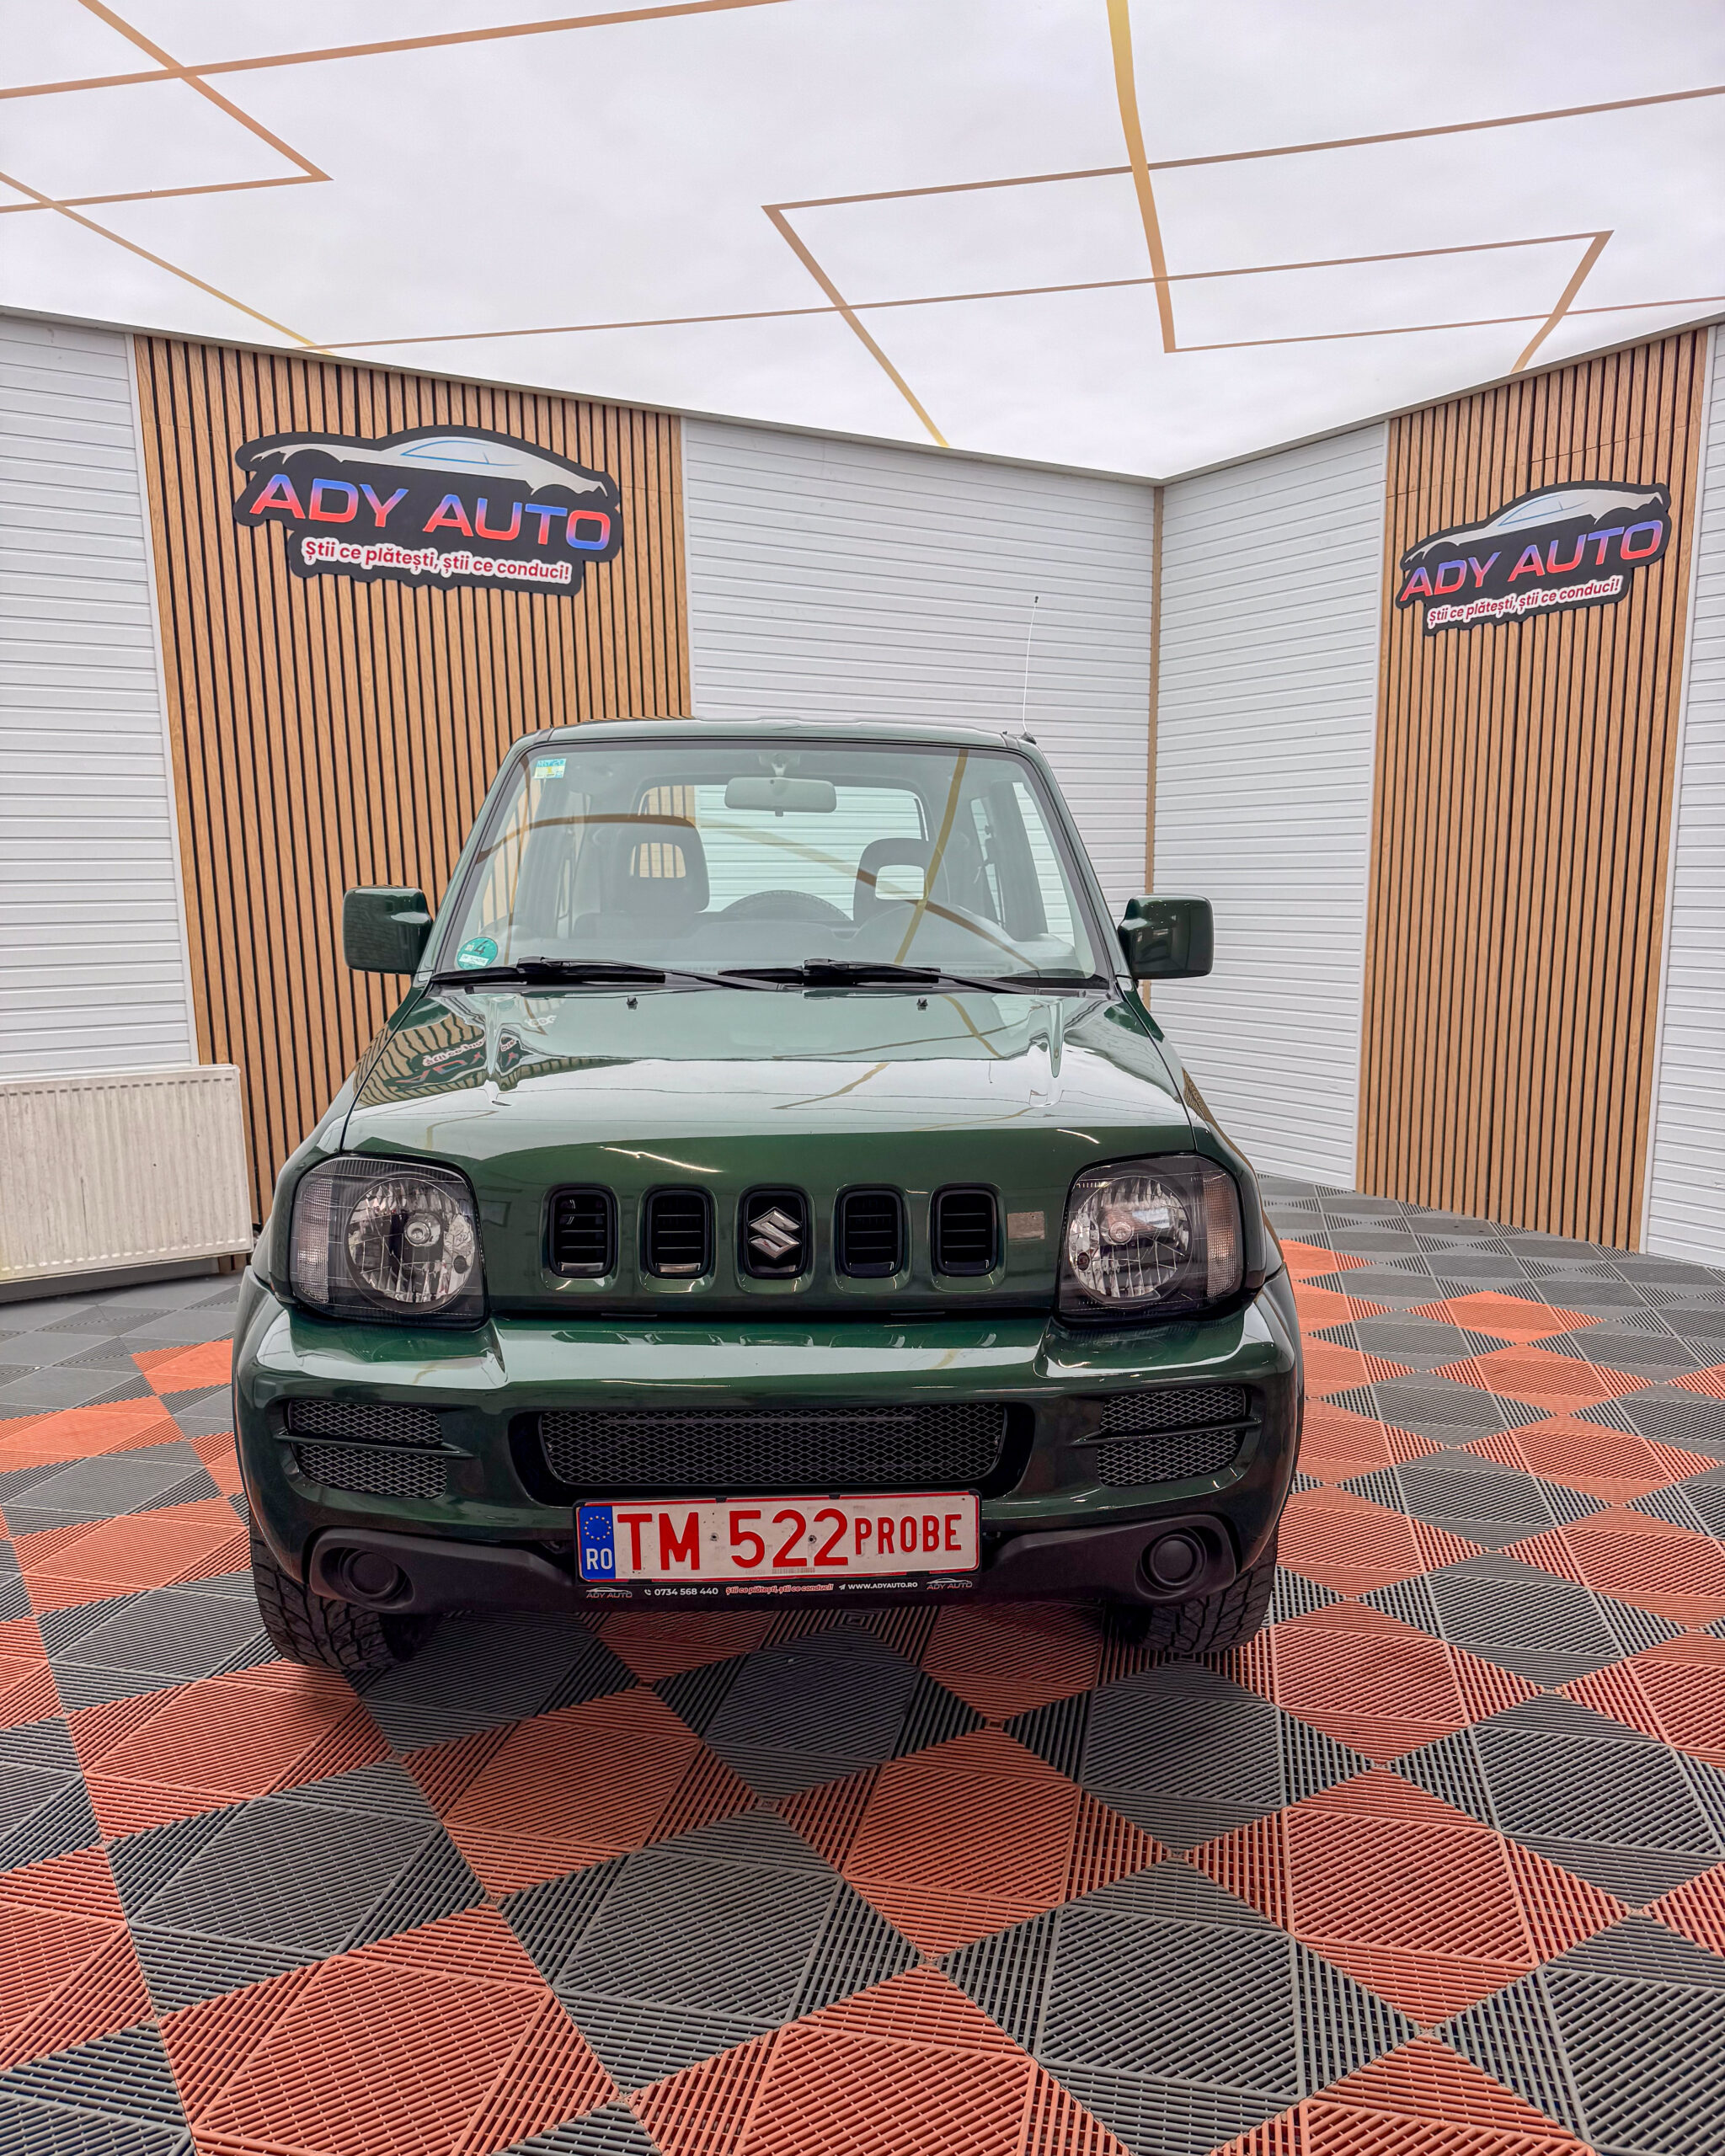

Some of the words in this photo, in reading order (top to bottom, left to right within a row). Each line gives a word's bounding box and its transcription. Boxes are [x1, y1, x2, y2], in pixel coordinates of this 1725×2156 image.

[249, 473, 409, 528] ADY
[423, 494, 611, 551] AUTO
[305, 541, 336, 561] Știi
[339, 547, 361, 559] ce
[365, 547, 439, 571] plătești,
[443, 554, 469, 574] știi
[473, 560, 493, 573] ce
[497, 563, 569, 580] conduci!
[1400, 552, 1502, 601] ADY
[1508, 520, 1664, 583] AUTO
[1429, 608, 1448, 626] Știi
[1450, 609, 1464, 619] ce
[1466, 596, 1516, 620] plătești,
[1519, 592, 1539, 611] știi
[1541, 592, 1557, 603] ce
[1559, 579, 1620, 600] conduci!
[585, 1548, 612, 1571] RO
[617, 1512, 700, 1571] TM
[729, 1508, 848, 1568] 522
[854, 1514, 962, 1556] PROBE
[847, 1582, 918, 1590] WWW.ADYAUTO.RO
[947, 1581, 973, 1589] AUTO
